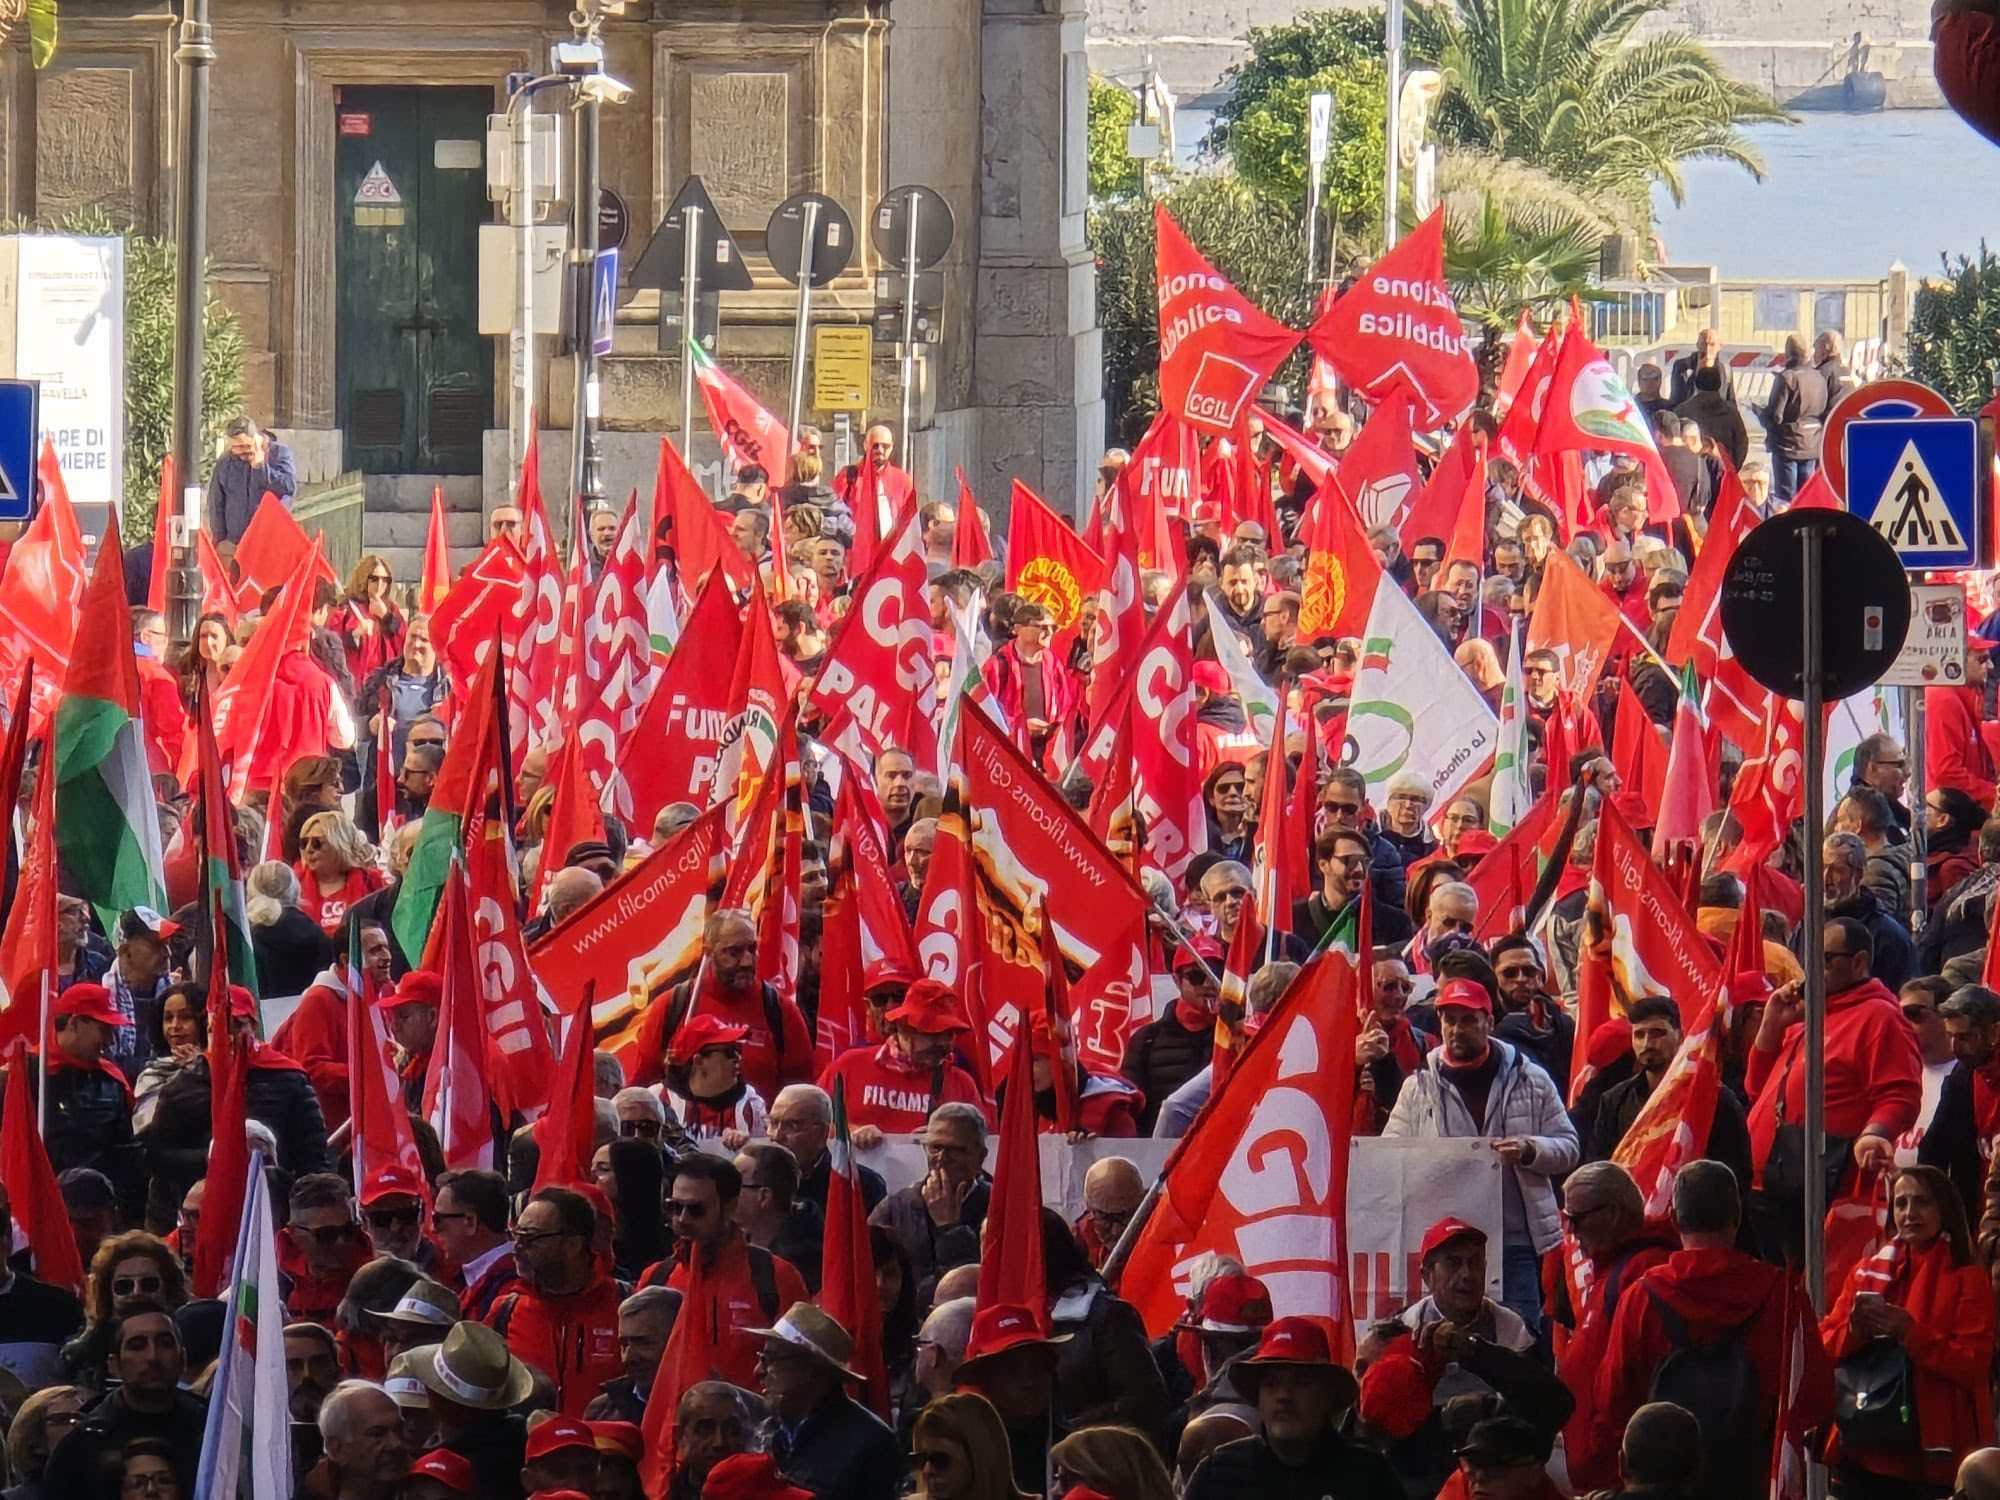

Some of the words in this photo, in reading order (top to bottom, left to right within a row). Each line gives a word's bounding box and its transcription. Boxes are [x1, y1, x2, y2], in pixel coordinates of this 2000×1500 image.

[1189, 393, 1231, 421] CGIL
[86, 429, 104, 447] DI
[862, 1084, 931, 1113] FILCAMS
